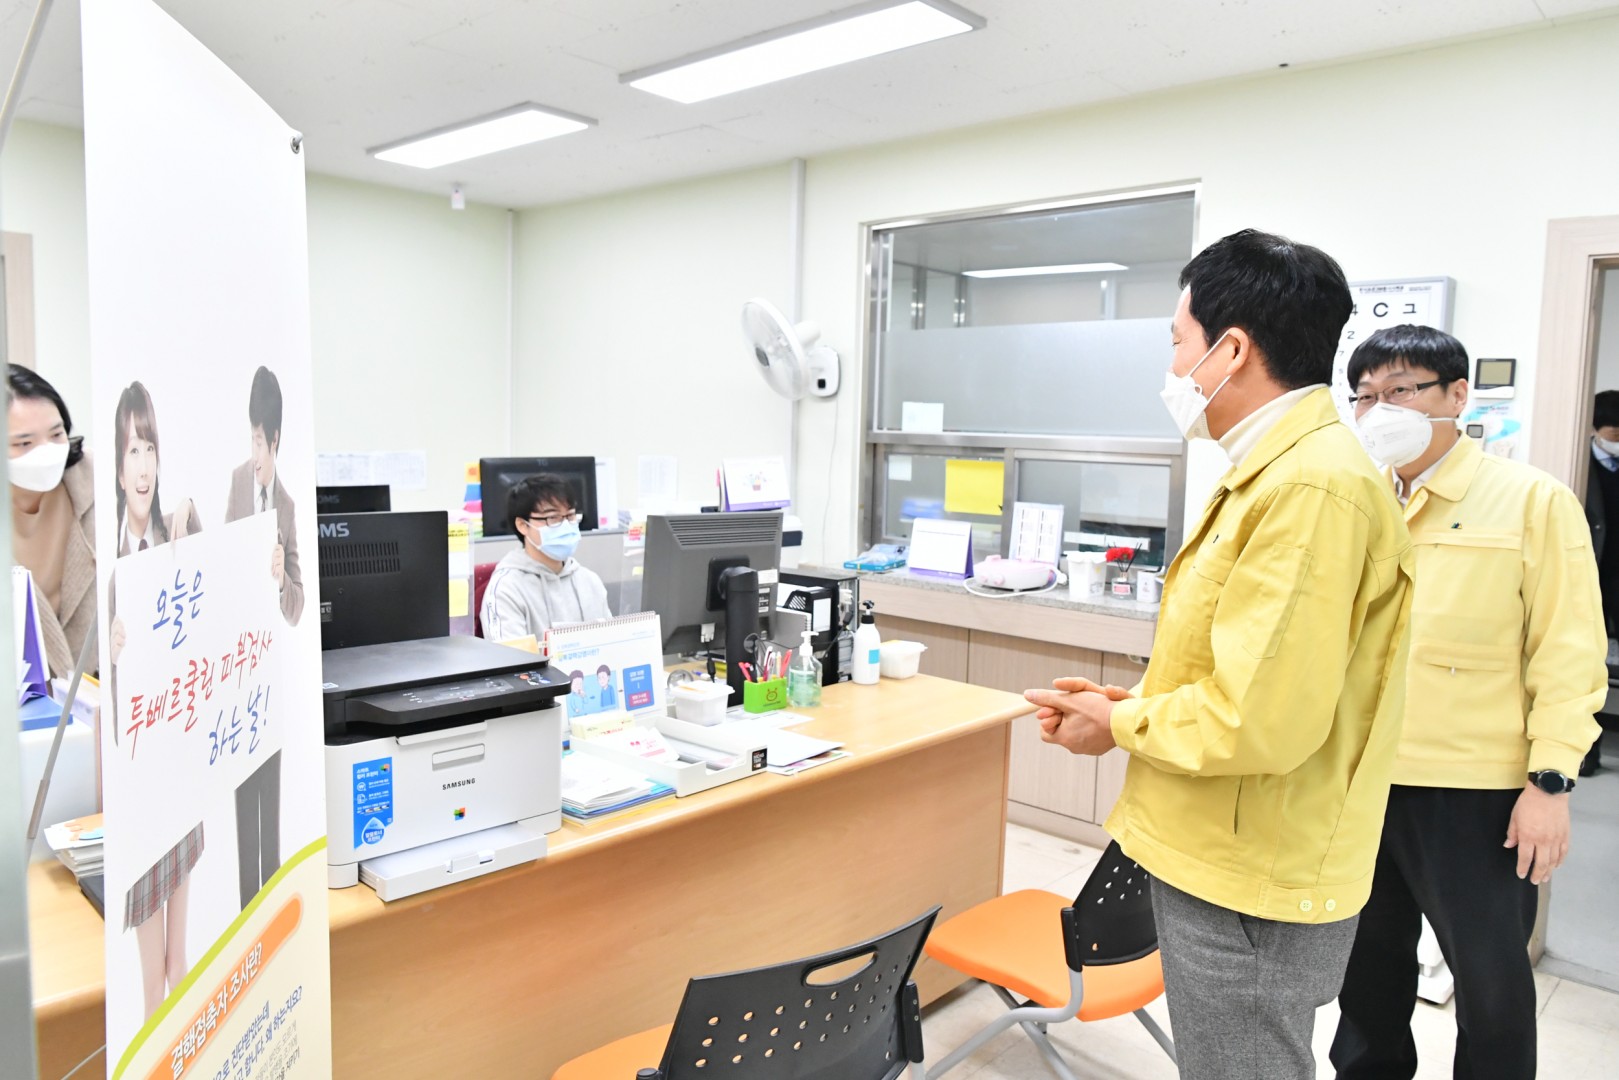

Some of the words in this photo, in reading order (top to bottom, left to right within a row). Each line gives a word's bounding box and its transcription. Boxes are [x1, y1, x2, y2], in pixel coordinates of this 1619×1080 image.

[317, 522, 350, 538] MS
[153, 569, 204, 649] 오늘은
[126, 658, 214, 760] 투베르쿨린
[221, 630, 272, 689] 피부검사
[209, 706, 243, 766] 하는
[247, 685, 270, 754] 날!
[442, 777, 476, 791] SAMSUNG
[171, 984, 229, 1080] 결핵접촉자
[229, 942, 262, 1002] 조사란?
[273, 985, 302, 1030] 하는지요?
